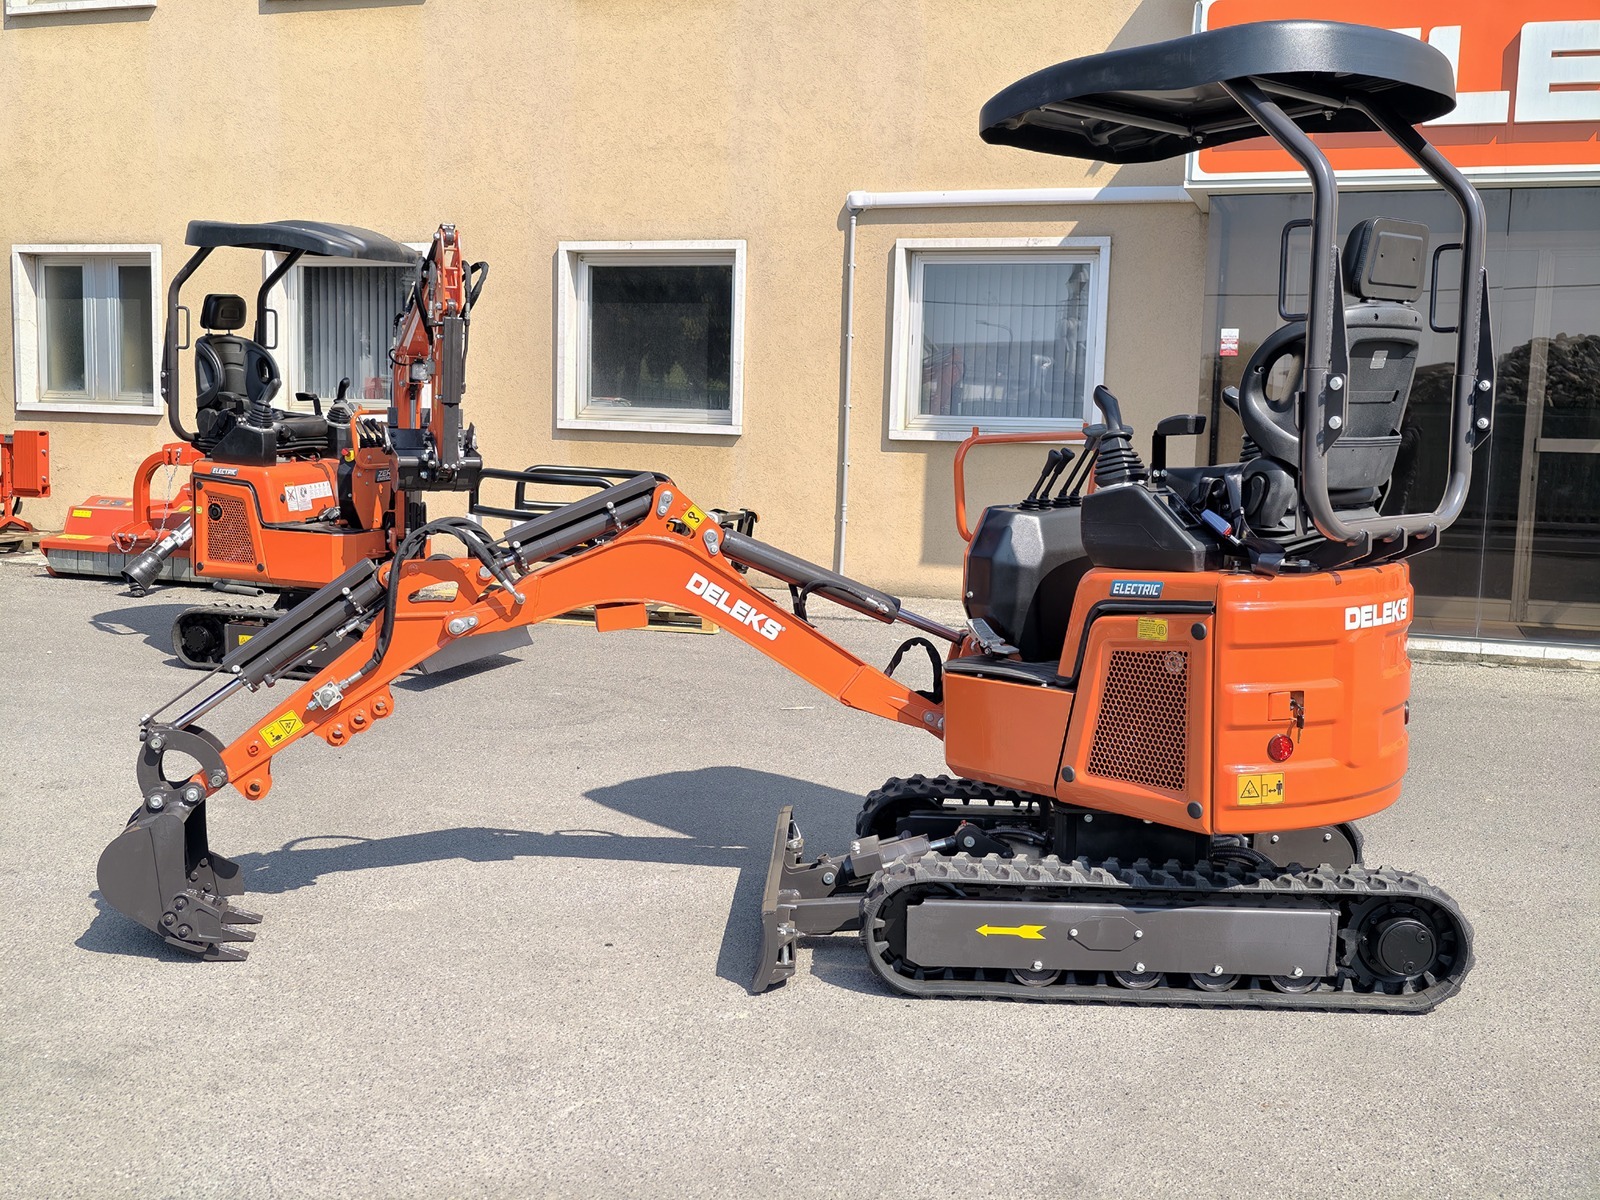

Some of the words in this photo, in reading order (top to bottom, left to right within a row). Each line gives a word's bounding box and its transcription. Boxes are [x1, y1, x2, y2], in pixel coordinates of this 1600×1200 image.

[1388, 20, 1600, 126] LE
[212, 467, 238, 476] ELECTRIC
[1112, 582, 1161, 596] ELECTRIC
[1344, 597, 1408, 631] DELEKS
